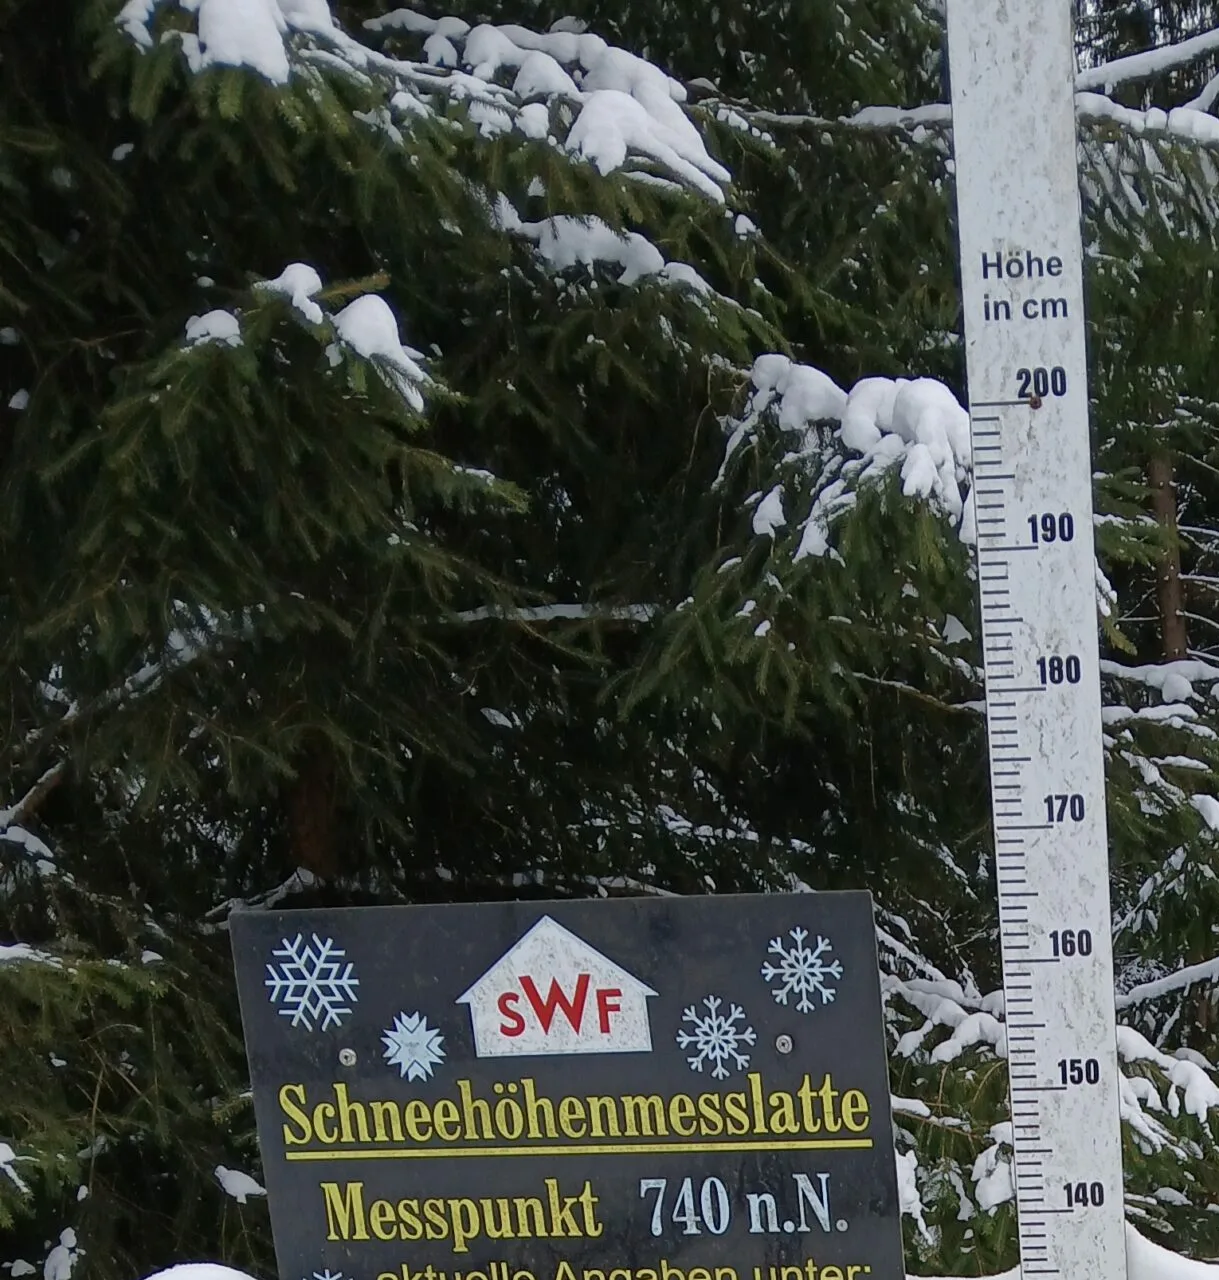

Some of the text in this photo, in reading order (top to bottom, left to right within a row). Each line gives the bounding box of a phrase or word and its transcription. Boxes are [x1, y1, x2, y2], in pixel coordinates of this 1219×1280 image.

[982, 251, 1063, 279] Höhe
[984, 294, 1068, 321] in cm
[1016, 366, 1067, 398] 200
[1028, 512, 1074, 543] 190
[1036, 655, 1081, 684] 180
[1044, 794, 1085, 822] 170
[1049, 930, 1092, 957] 160
[498, 973, 622, 1038] SWF
[1058, 1059, 1099, 1085] 150
[278, 1072, 870, 1145] Schneehöhenmesslatte
[1063, 1181, 1104, 1207] 140
[320, 1178, 603, 1252] Messpunkt
[640, 1176, 730, 1237] 740
